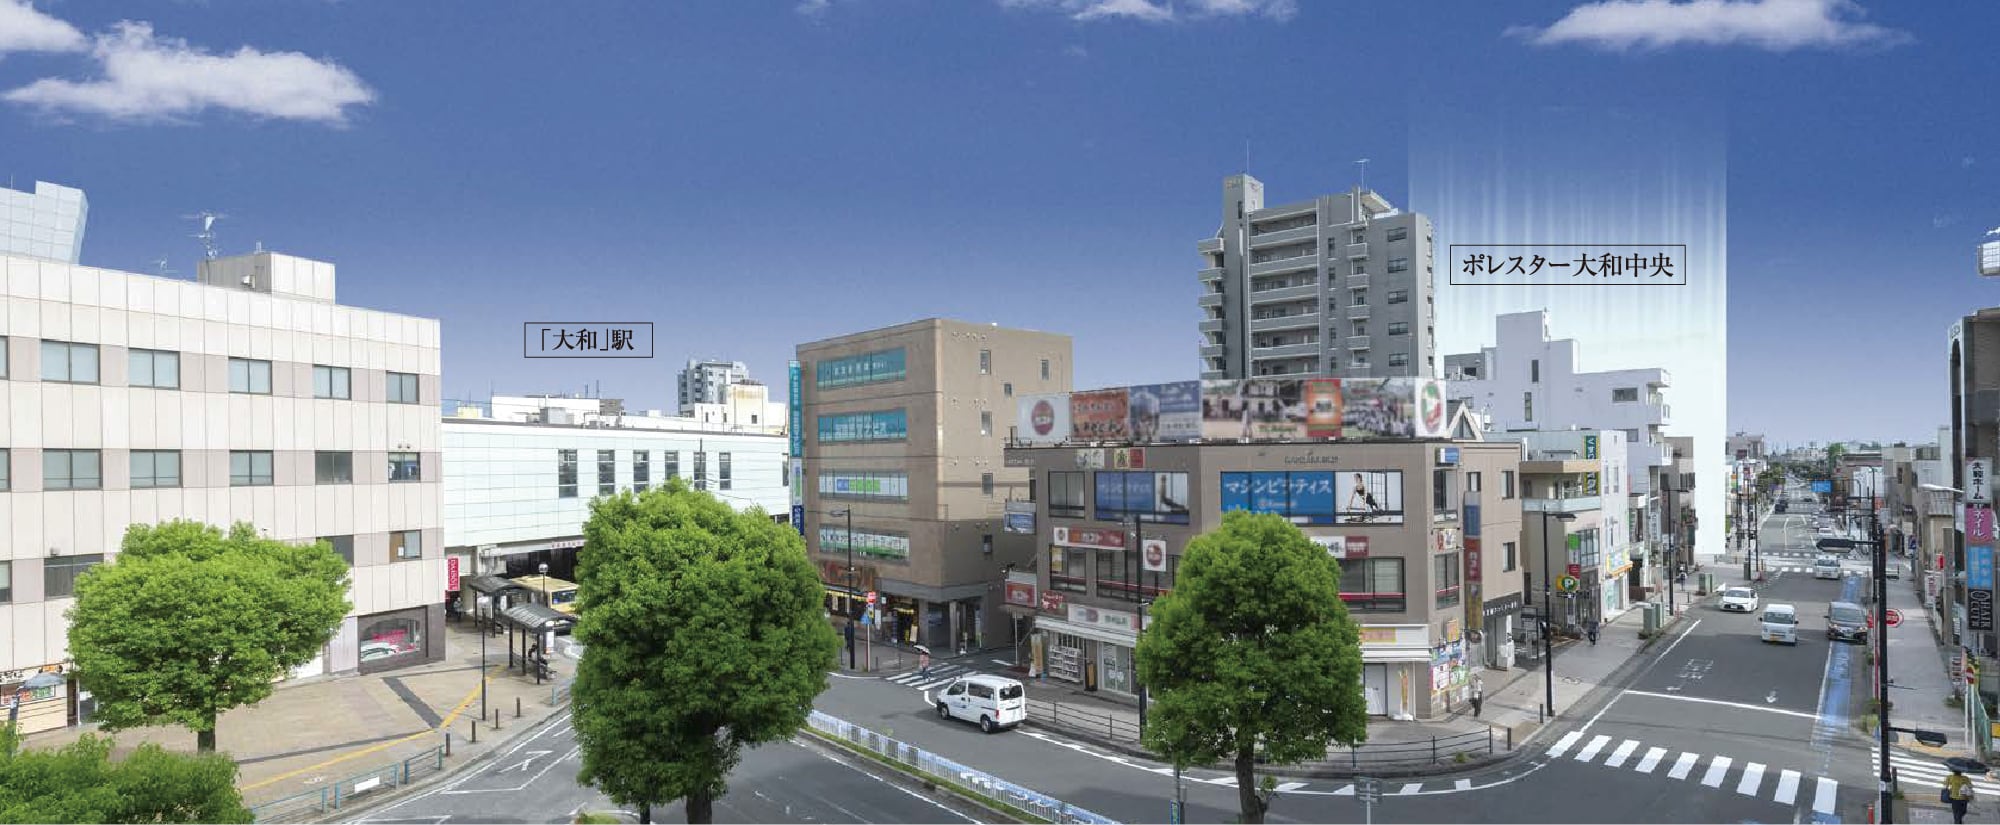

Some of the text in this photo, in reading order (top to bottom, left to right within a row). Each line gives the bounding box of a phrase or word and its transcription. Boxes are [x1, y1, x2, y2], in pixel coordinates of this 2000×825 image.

[1225, 478, 1332, 495] マシンピラティス
